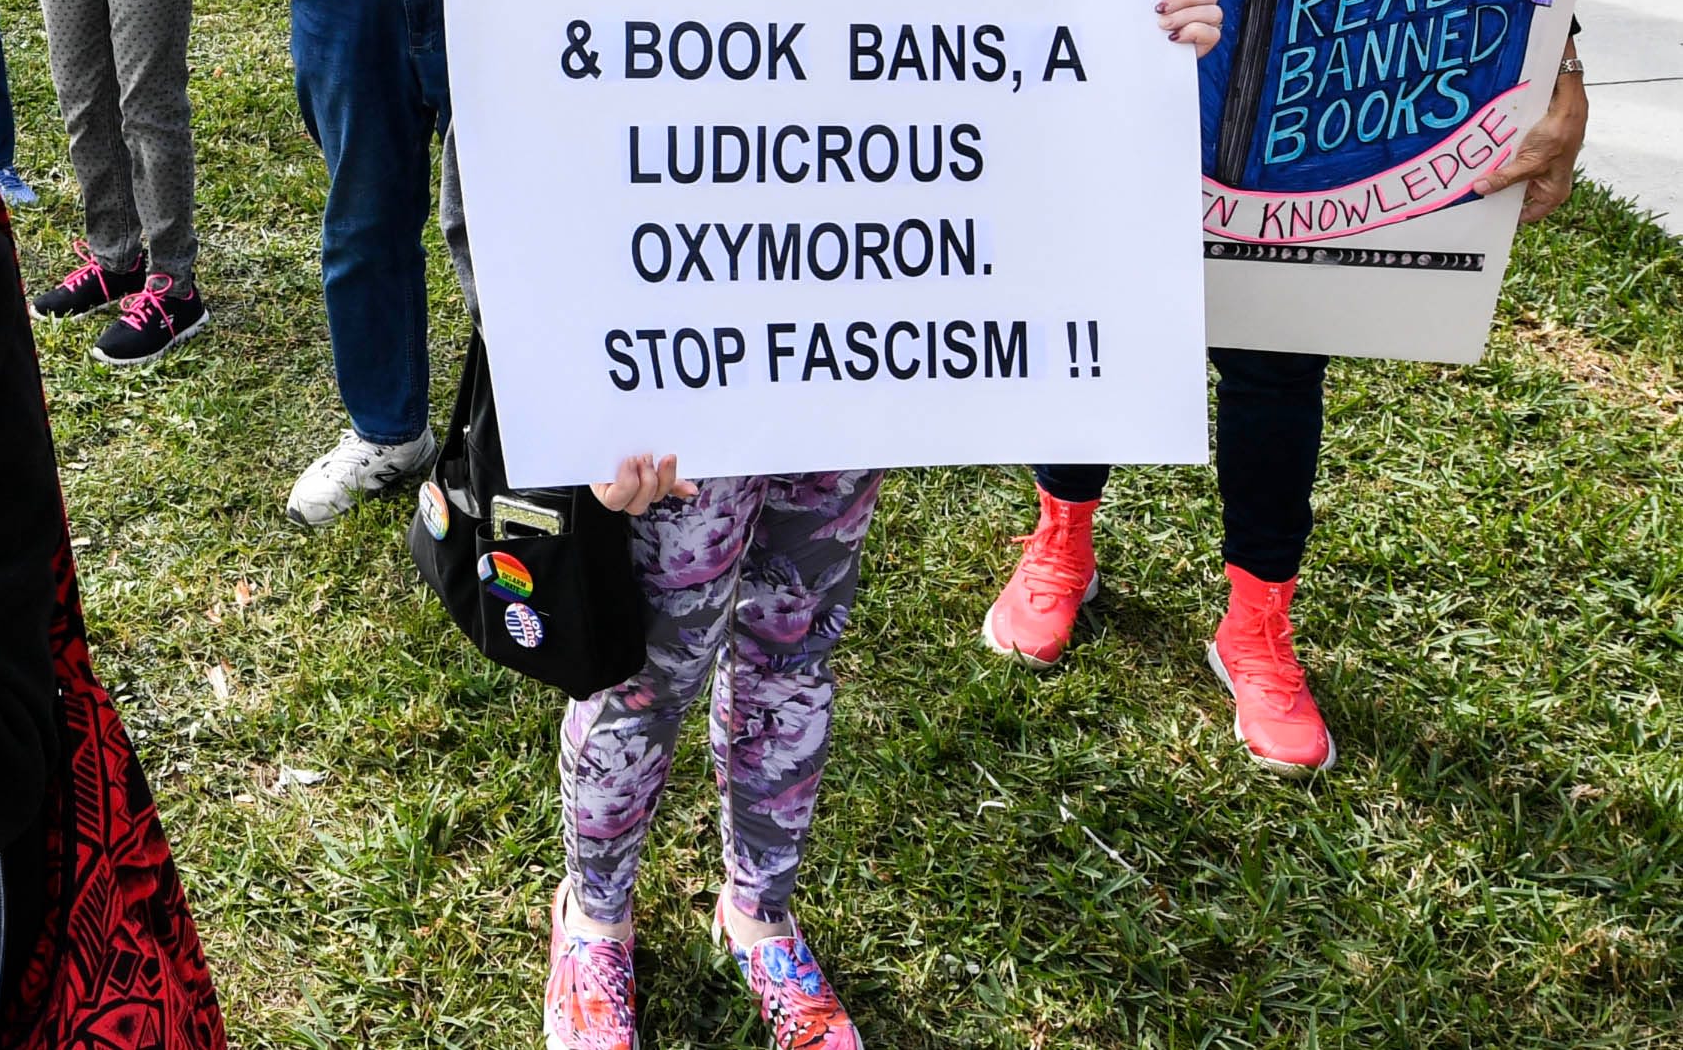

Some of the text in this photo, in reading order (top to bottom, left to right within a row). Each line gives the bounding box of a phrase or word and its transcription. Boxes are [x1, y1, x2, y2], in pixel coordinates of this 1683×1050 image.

[561, 19, 1087, 92] & BOOK BANS, A
[1276, 5, 1509, 106] BANNED
[629, 123, 985, 184] LUDICROUS
[1265, 69, 1470, 165] BOOKS
[1202, 107, 1519, 240] N KNOWLEDGE
[631, 218, 994, 283] OXYMORON.
[604, 326, 746, 392] STOP
[768, 320, 1028, 382] FASCISM
